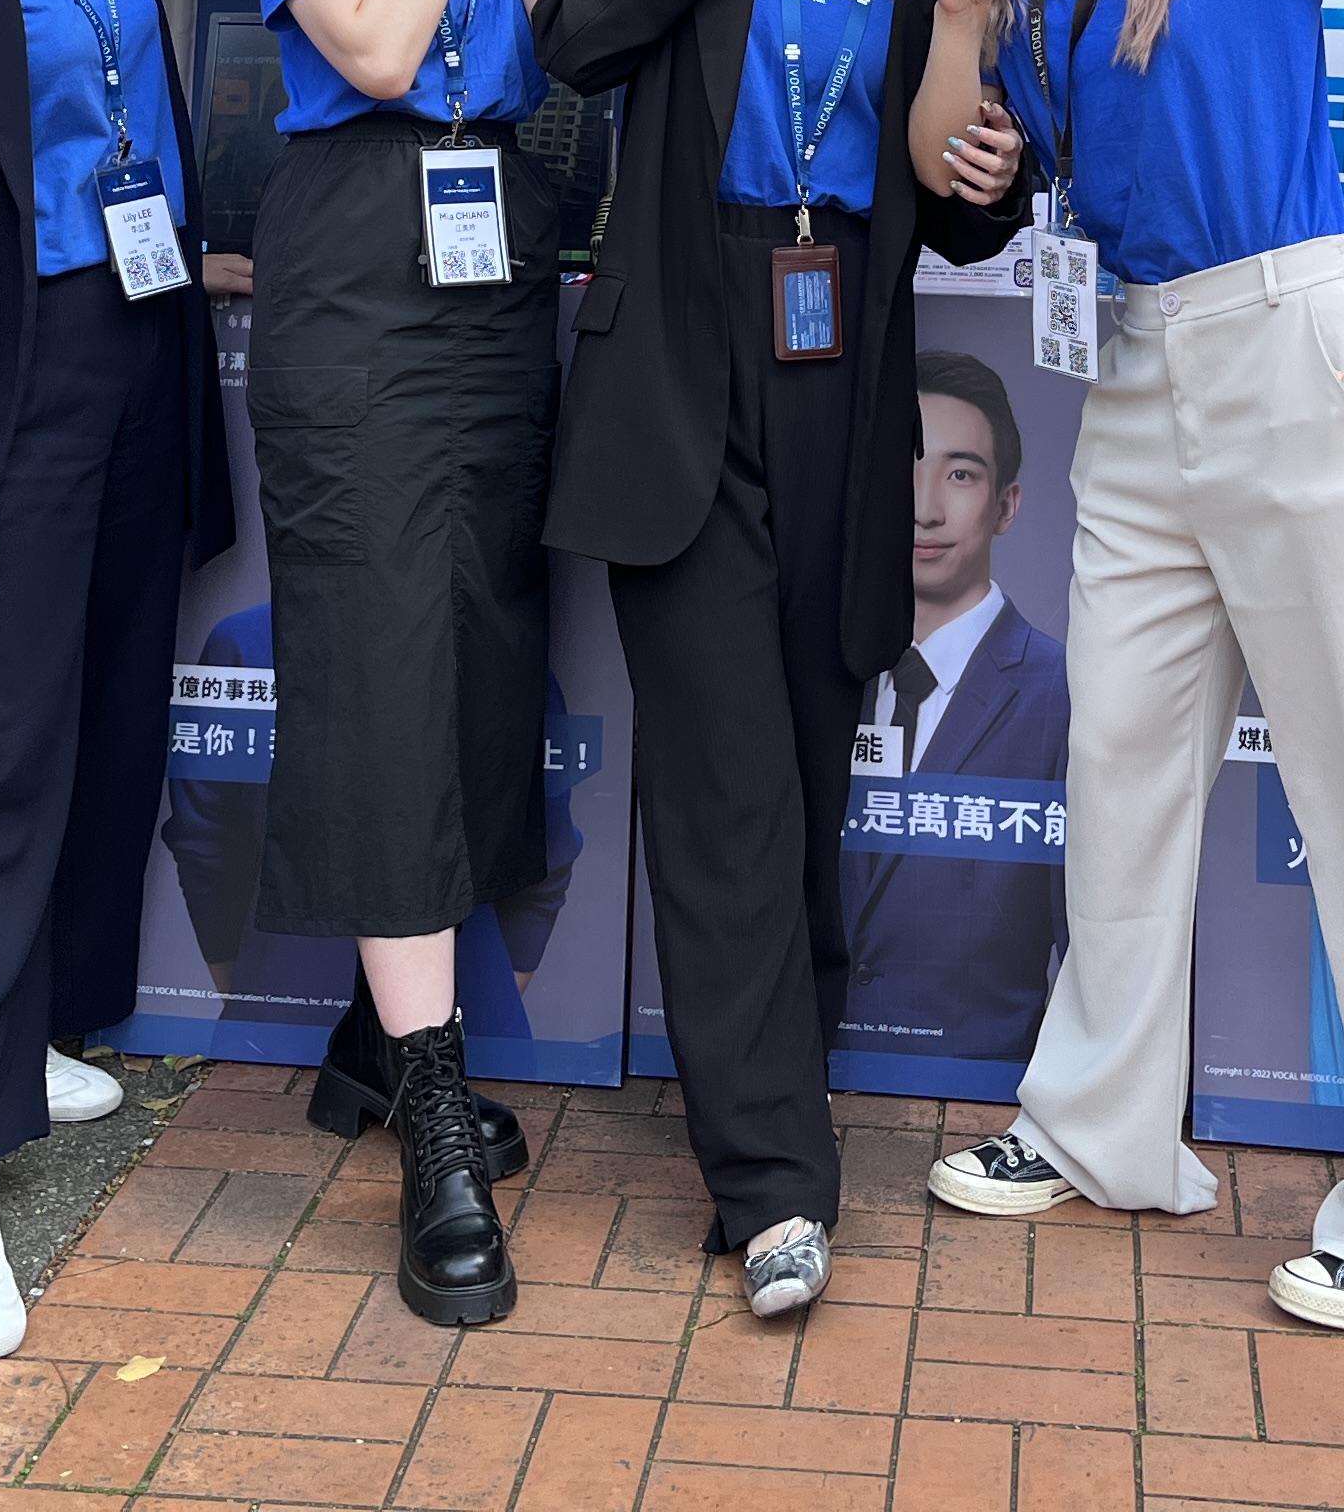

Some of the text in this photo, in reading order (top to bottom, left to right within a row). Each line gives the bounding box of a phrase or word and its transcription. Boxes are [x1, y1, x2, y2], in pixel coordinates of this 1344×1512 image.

[99, 24, 113, 63] VOCAL
[1030, 16, 1044, 67] MIDDLE
[788, 68, 802, 108] VOCAL
[813, 54, 852, 137] VOCAL MIDDLE
[138, 207, 153, 220] LEE
[455, 211, 490, 221] CHIANG
[171, 720, 276, 760] 是你！
[155, 986, 178, 996] VOCAL
[180, 988, 207, 999] MIDDLE
[207, 990, 266, 1003] Communications
[889, 1025, 911, 1035] rights
[911, 1027, 944, 1037] reserved
[1204, 1064, 1243, 1078] Copyright
[1252, 1069, 1271, 1079] 2022
[1272, 1071, 1299, 1081] VOCAL
[1300, 1073, 1331, 1084] MIDDLE
